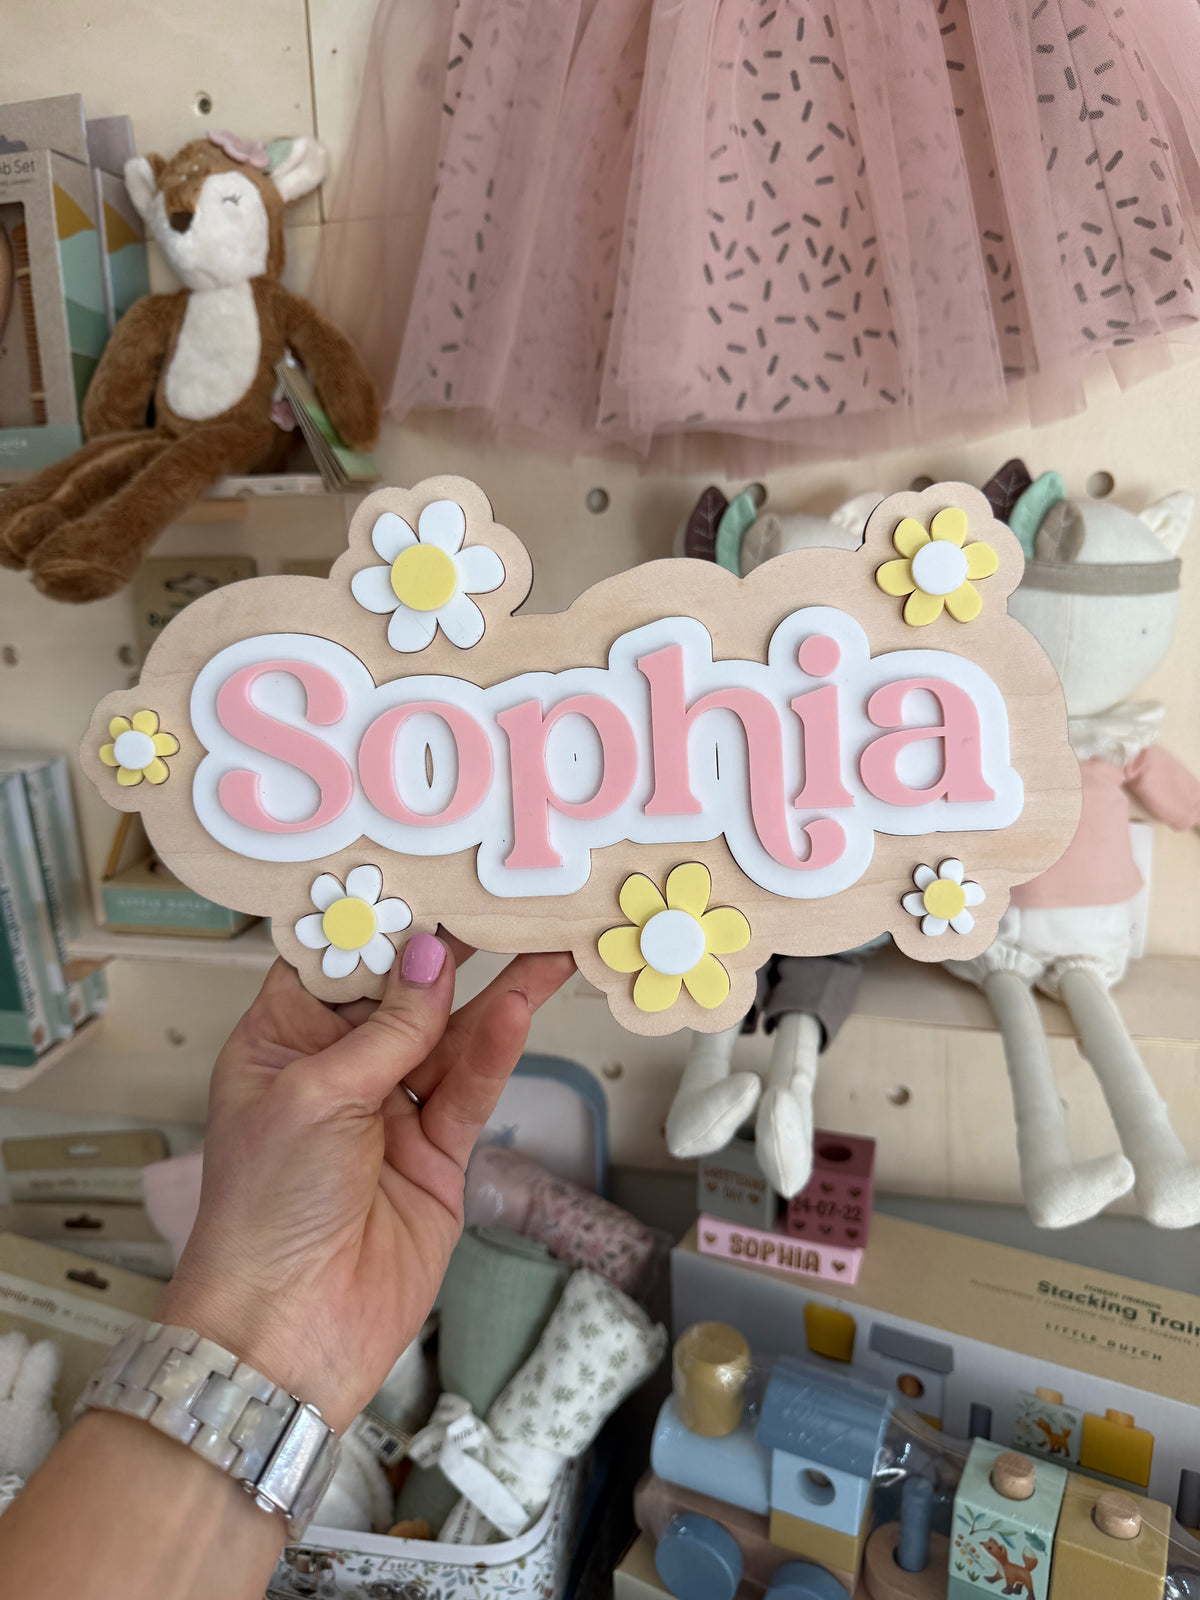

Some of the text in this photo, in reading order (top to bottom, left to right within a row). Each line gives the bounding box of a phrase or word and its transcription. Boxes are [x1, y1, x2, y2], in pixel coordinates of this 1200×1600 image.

[217, 634, 996, 869] Sophia
[728, 1233, 820, 1274] SOPHIA
[1036, 1279, 1138, 1322] Stacking
